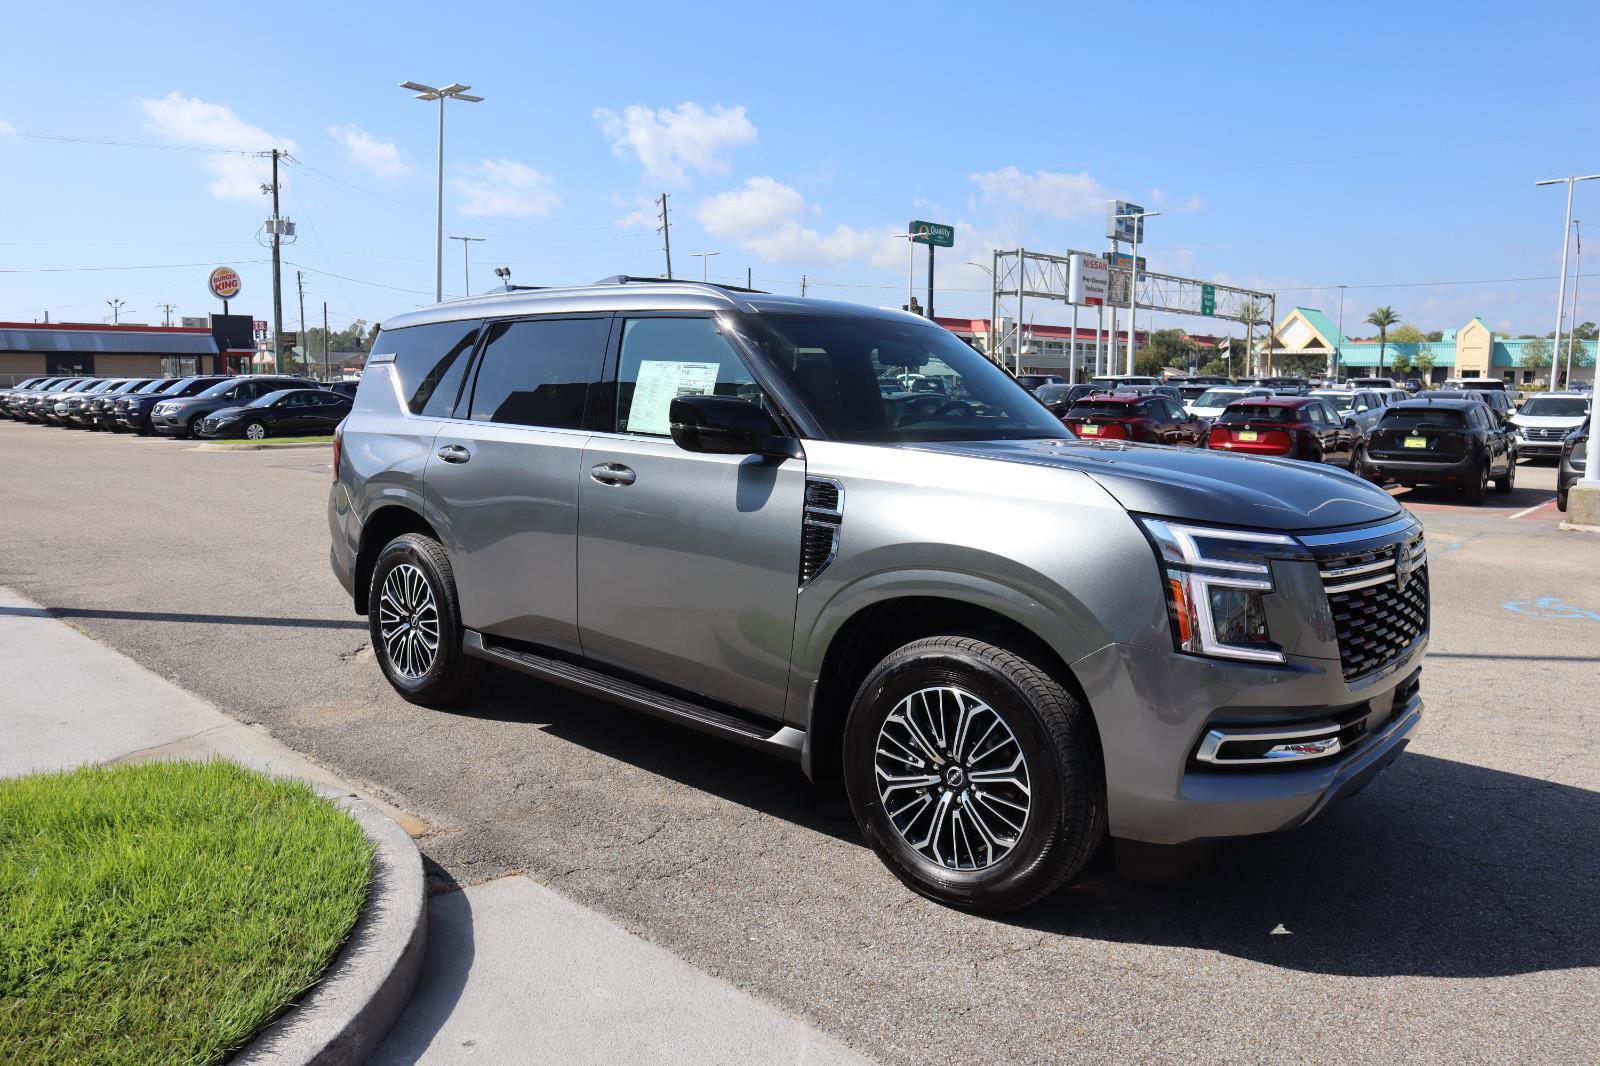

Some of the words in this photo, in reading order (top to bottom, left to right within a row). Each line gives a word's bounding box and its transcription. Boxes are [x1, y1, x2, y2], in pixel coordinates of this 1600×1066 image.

[930, 226, 951, 237] Quality
[1083, 259, 1108, 271] NISSAN
[213, 273, 237, 284] BURGER
[1082, 276, 1107, 286] Pre-Owned
[214, 280, 238, 292] KING
[1085, 285, 1104, 294] Vehicles
